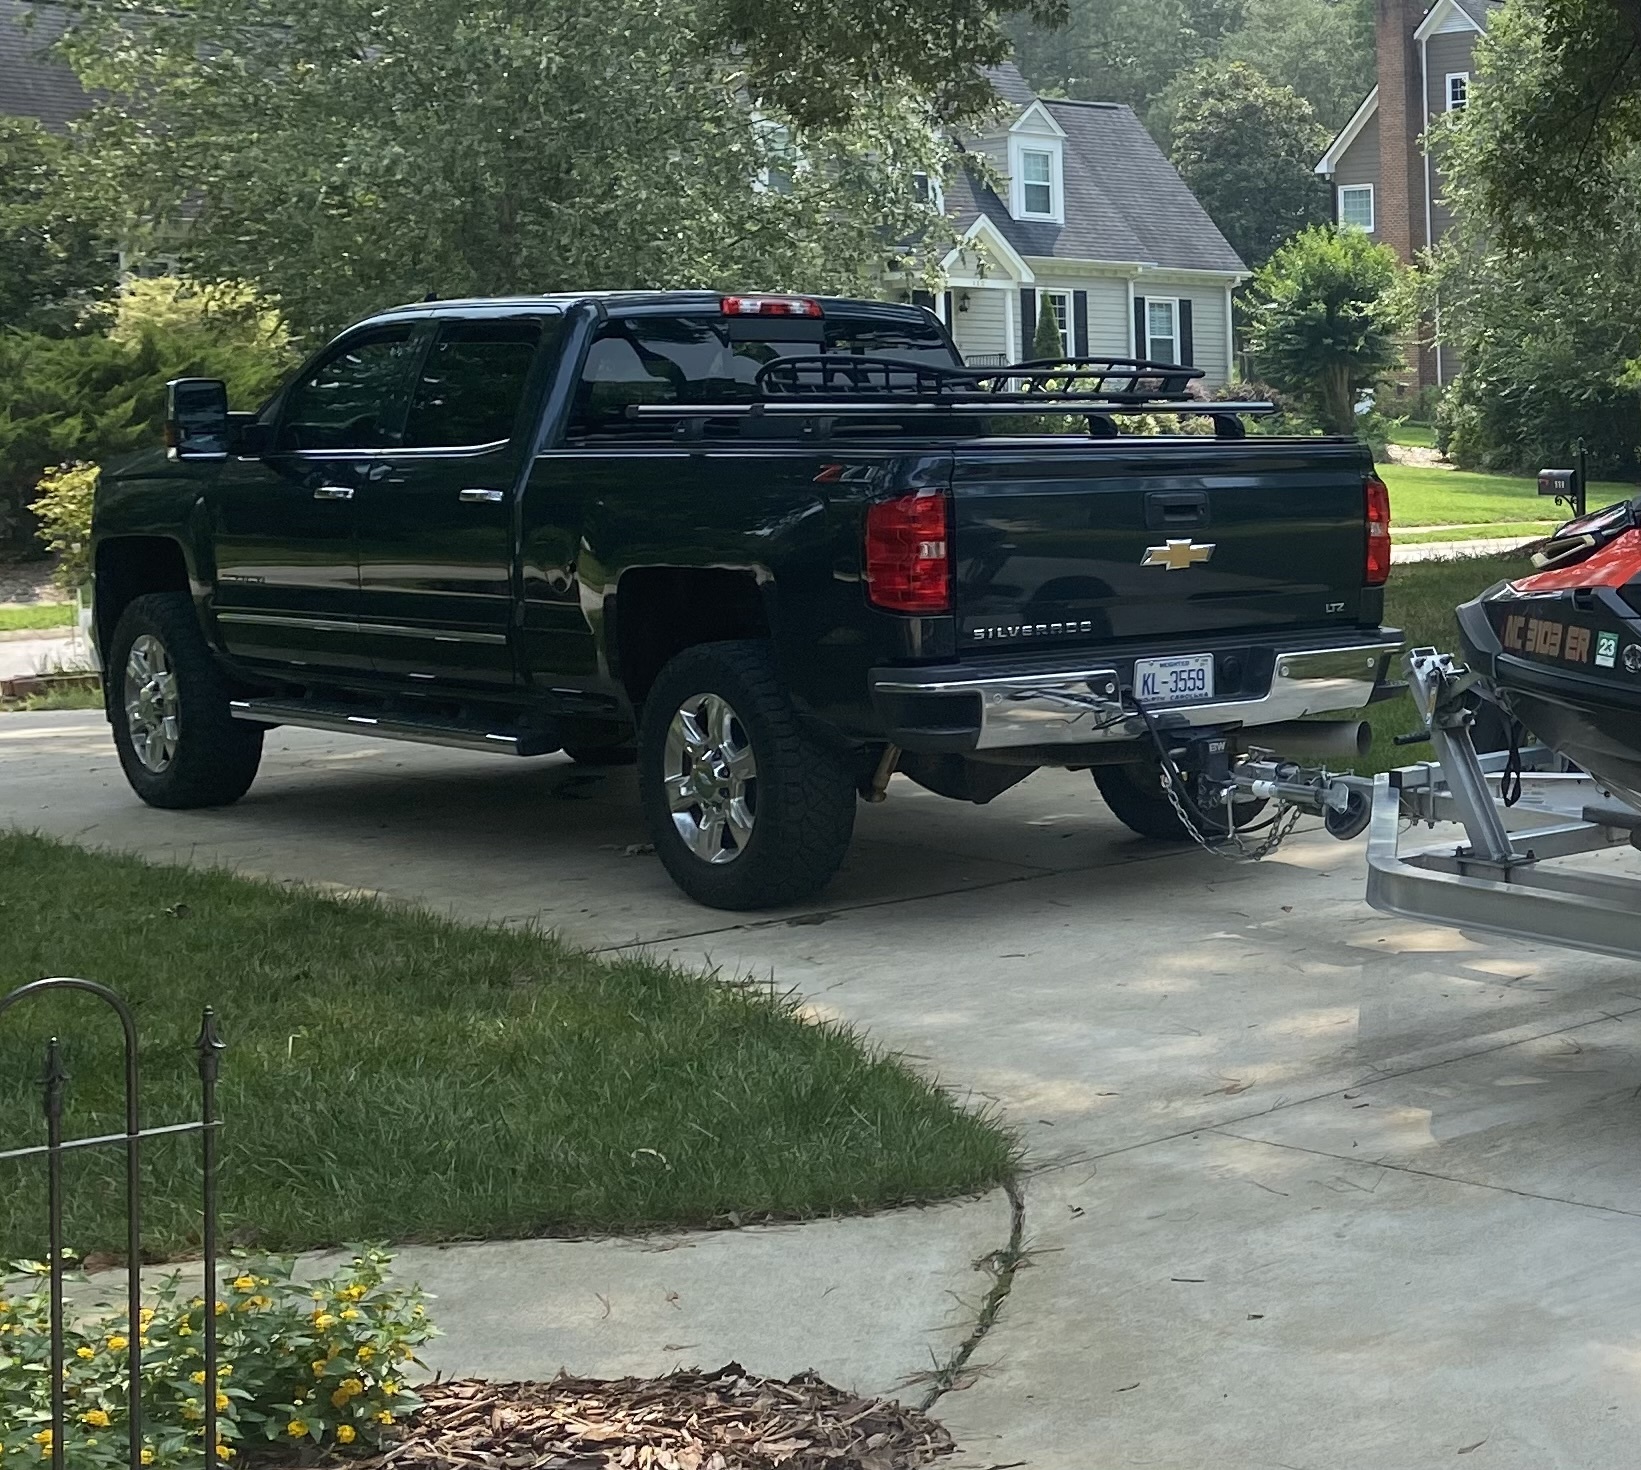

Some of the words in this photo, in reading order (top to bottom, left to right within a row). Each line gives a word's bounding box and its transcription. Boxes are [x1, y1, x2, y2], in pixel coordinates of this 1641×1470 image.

[812, 464, 880, 482] Z71
[1325, 602, 1345, 613] LTZ
[973, 620, 1092, 640] SILVERADO
[1503, 614, 1526, 650] NC
[1525, 617, 1564, 658] 3103
[1564, 625, 1591, 665] ER
[1599, 637, 1617, 657] 23
[1141, 668, 1206, 696] KL-3559
